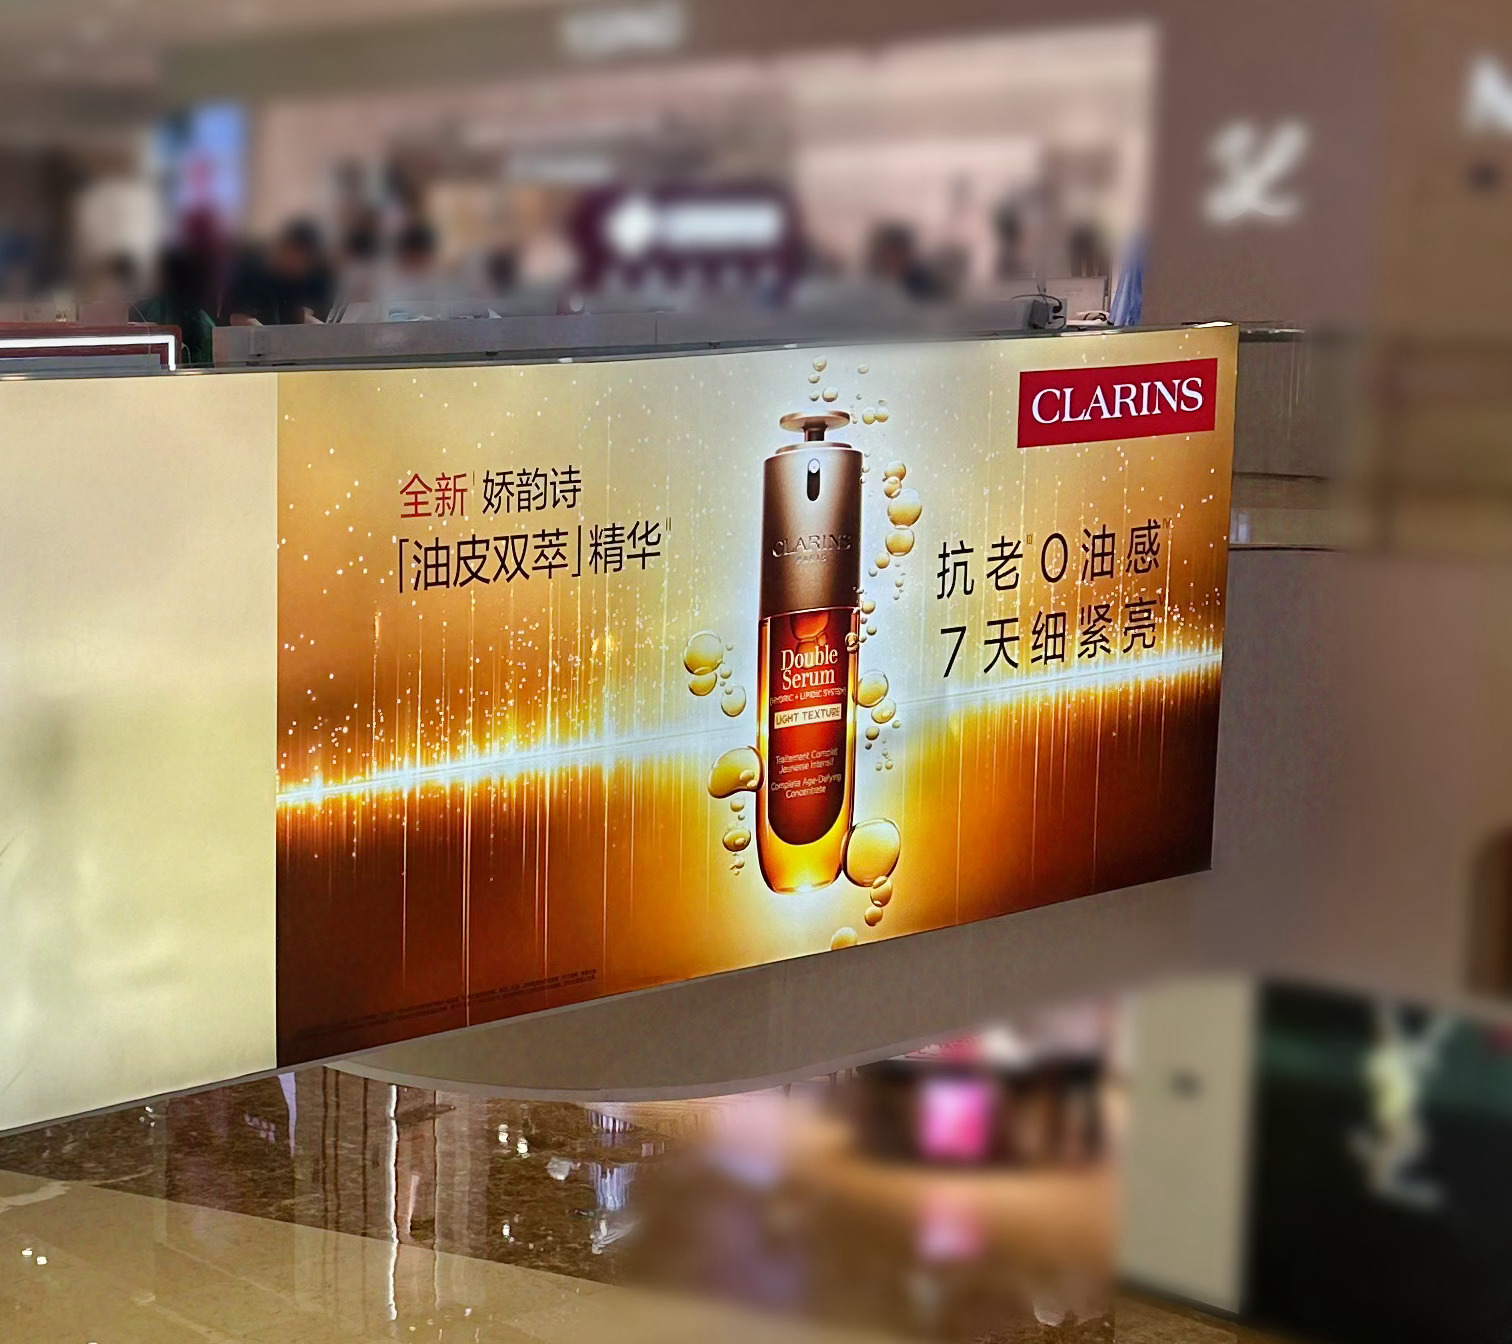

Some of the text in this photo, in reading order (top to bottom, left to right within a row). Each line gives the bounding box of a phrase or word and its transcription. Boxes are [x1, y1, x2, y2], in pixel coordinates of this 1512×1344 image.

[1031, 377, 1204, 424] CLARINS
[772, 534, 852, 558] CLARINS
[796, 554, 827, 565] PARIS
[781, 645, 838, 671] Double
[782, 669, 836, 690] Serum
[802, 707, 840, 721] TEXTURE
